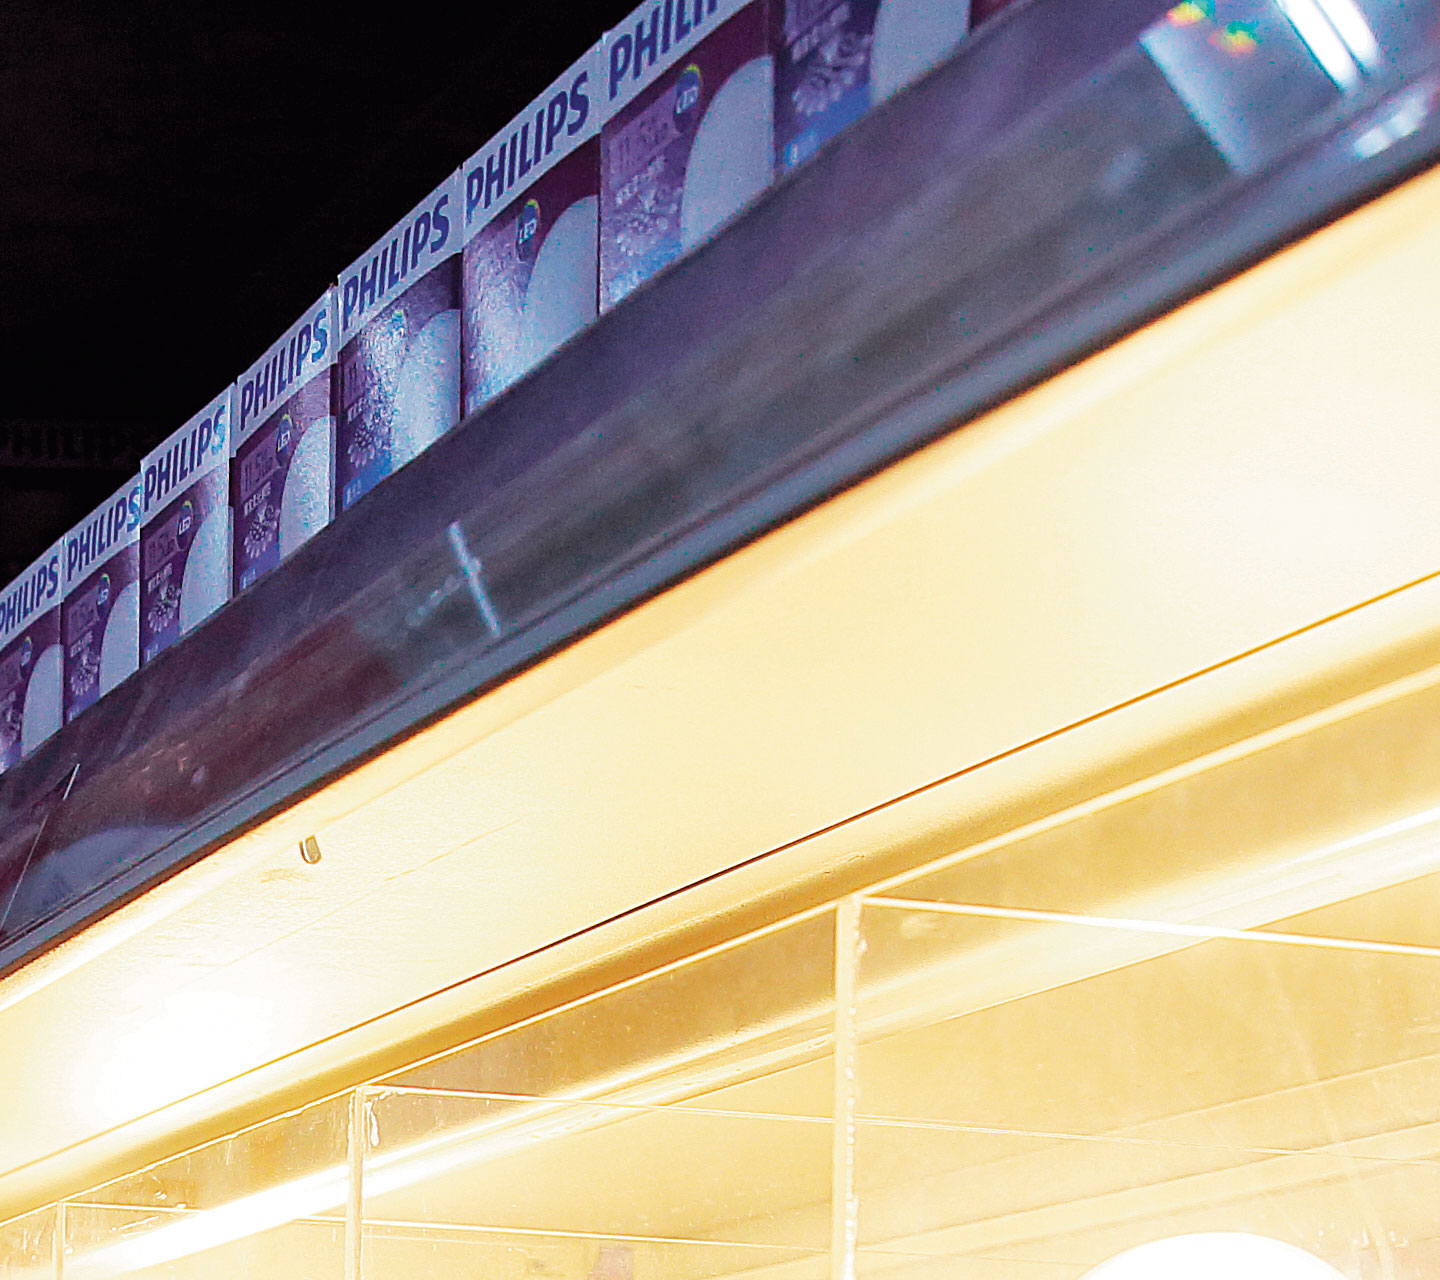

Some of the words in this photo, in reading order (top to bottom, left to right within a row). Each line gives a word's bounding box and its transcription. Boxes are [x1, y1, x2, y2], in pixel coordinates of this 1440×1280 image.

[609, 0, 717, 100] PHIL
[466, 70, 589, 224] PHILIPS
[343, 194, 449, 331] PHILIPS
[241, 310, 328, 430] PHILIPS
[143, 404, 226, 512] PHILIPS
[277, 430, 291, 452] LED
[66, 486, 140, 582] PHILIPS
[178, 516, 191, 536] LED
